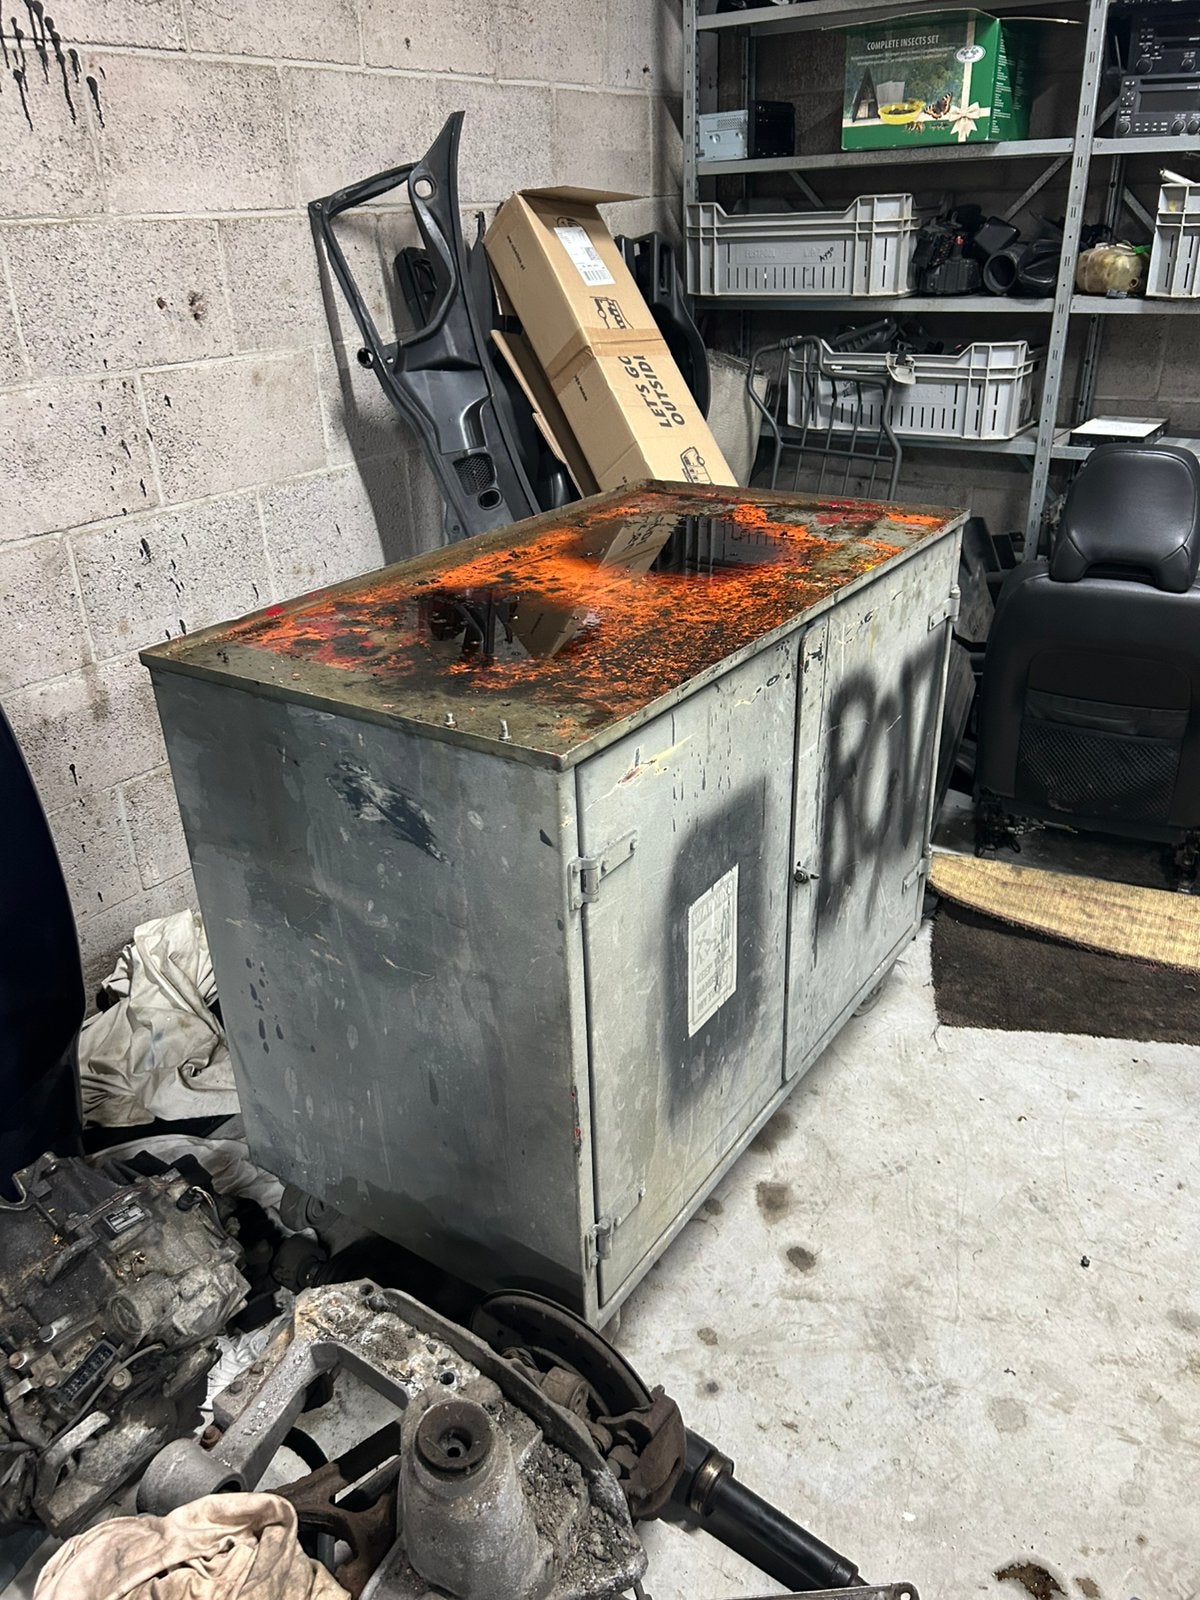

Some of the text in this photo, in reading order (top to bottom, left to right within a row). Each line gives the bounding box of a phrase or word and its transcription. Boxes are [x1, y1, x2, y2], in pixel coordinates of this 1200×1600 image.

[867, 34, 939, 51] COMPLETE INSECTS SET
[635, 384, 673, 428] LET'S
